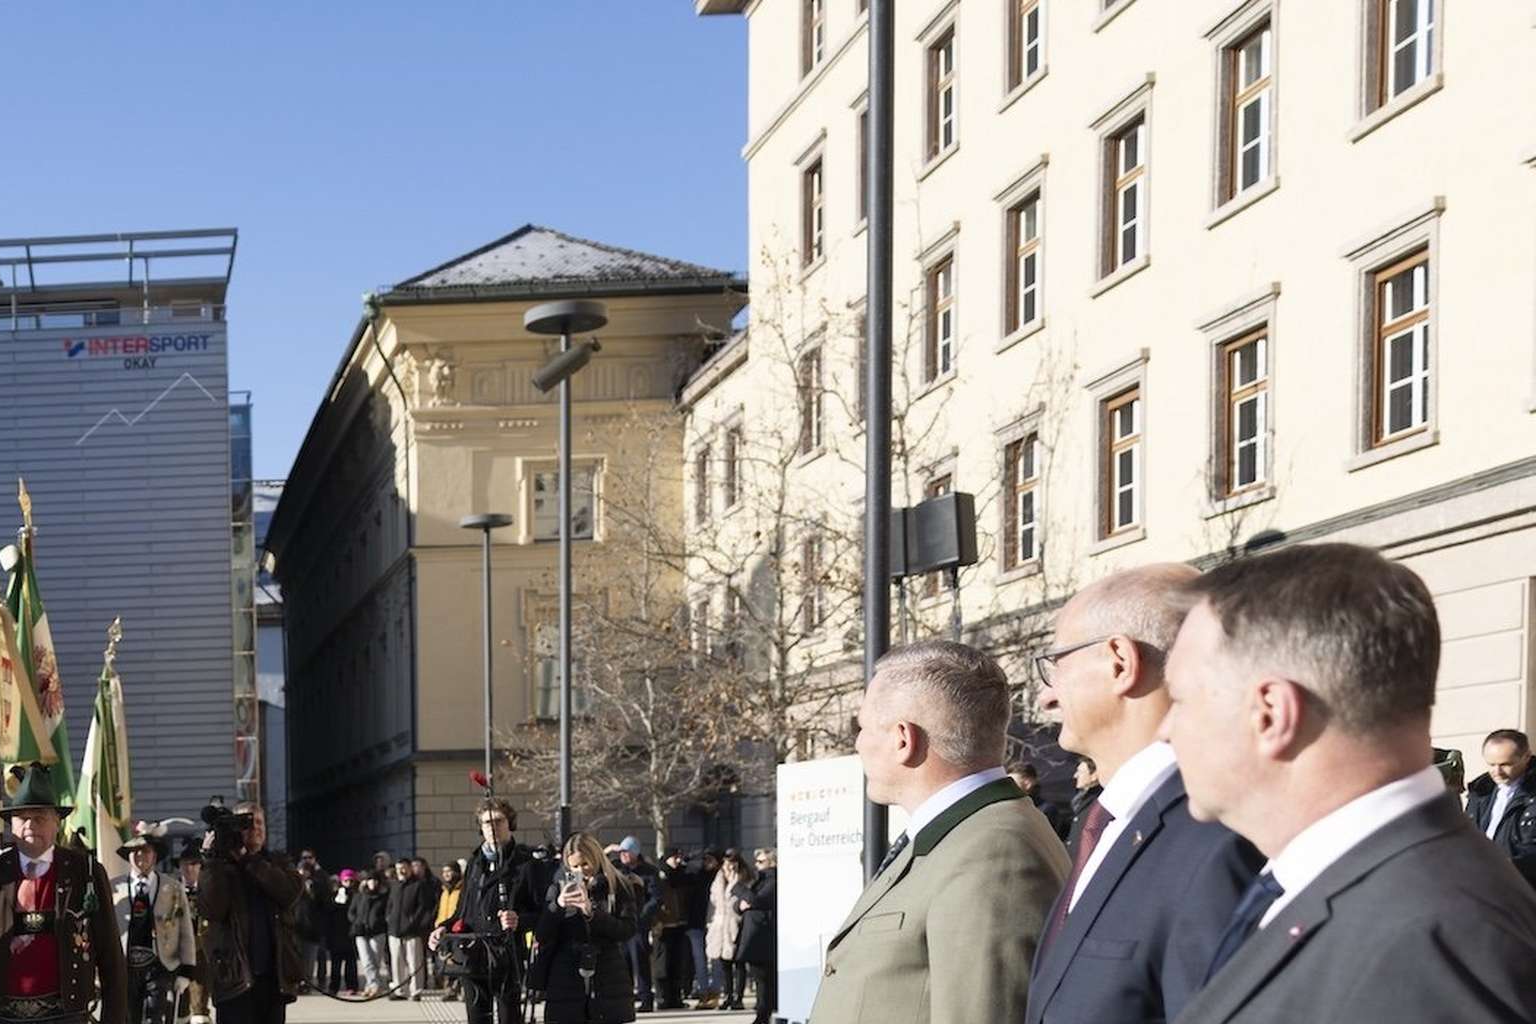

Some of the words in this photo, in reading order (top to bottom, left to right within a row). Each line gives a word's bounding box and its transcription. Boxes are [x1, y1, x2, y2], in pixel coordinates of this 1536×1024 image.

[88, 335, 211, 355] INTERSPORT
[124, 356, 157, 369] OKAY
[790, 807, 830, 827] Bergauf
